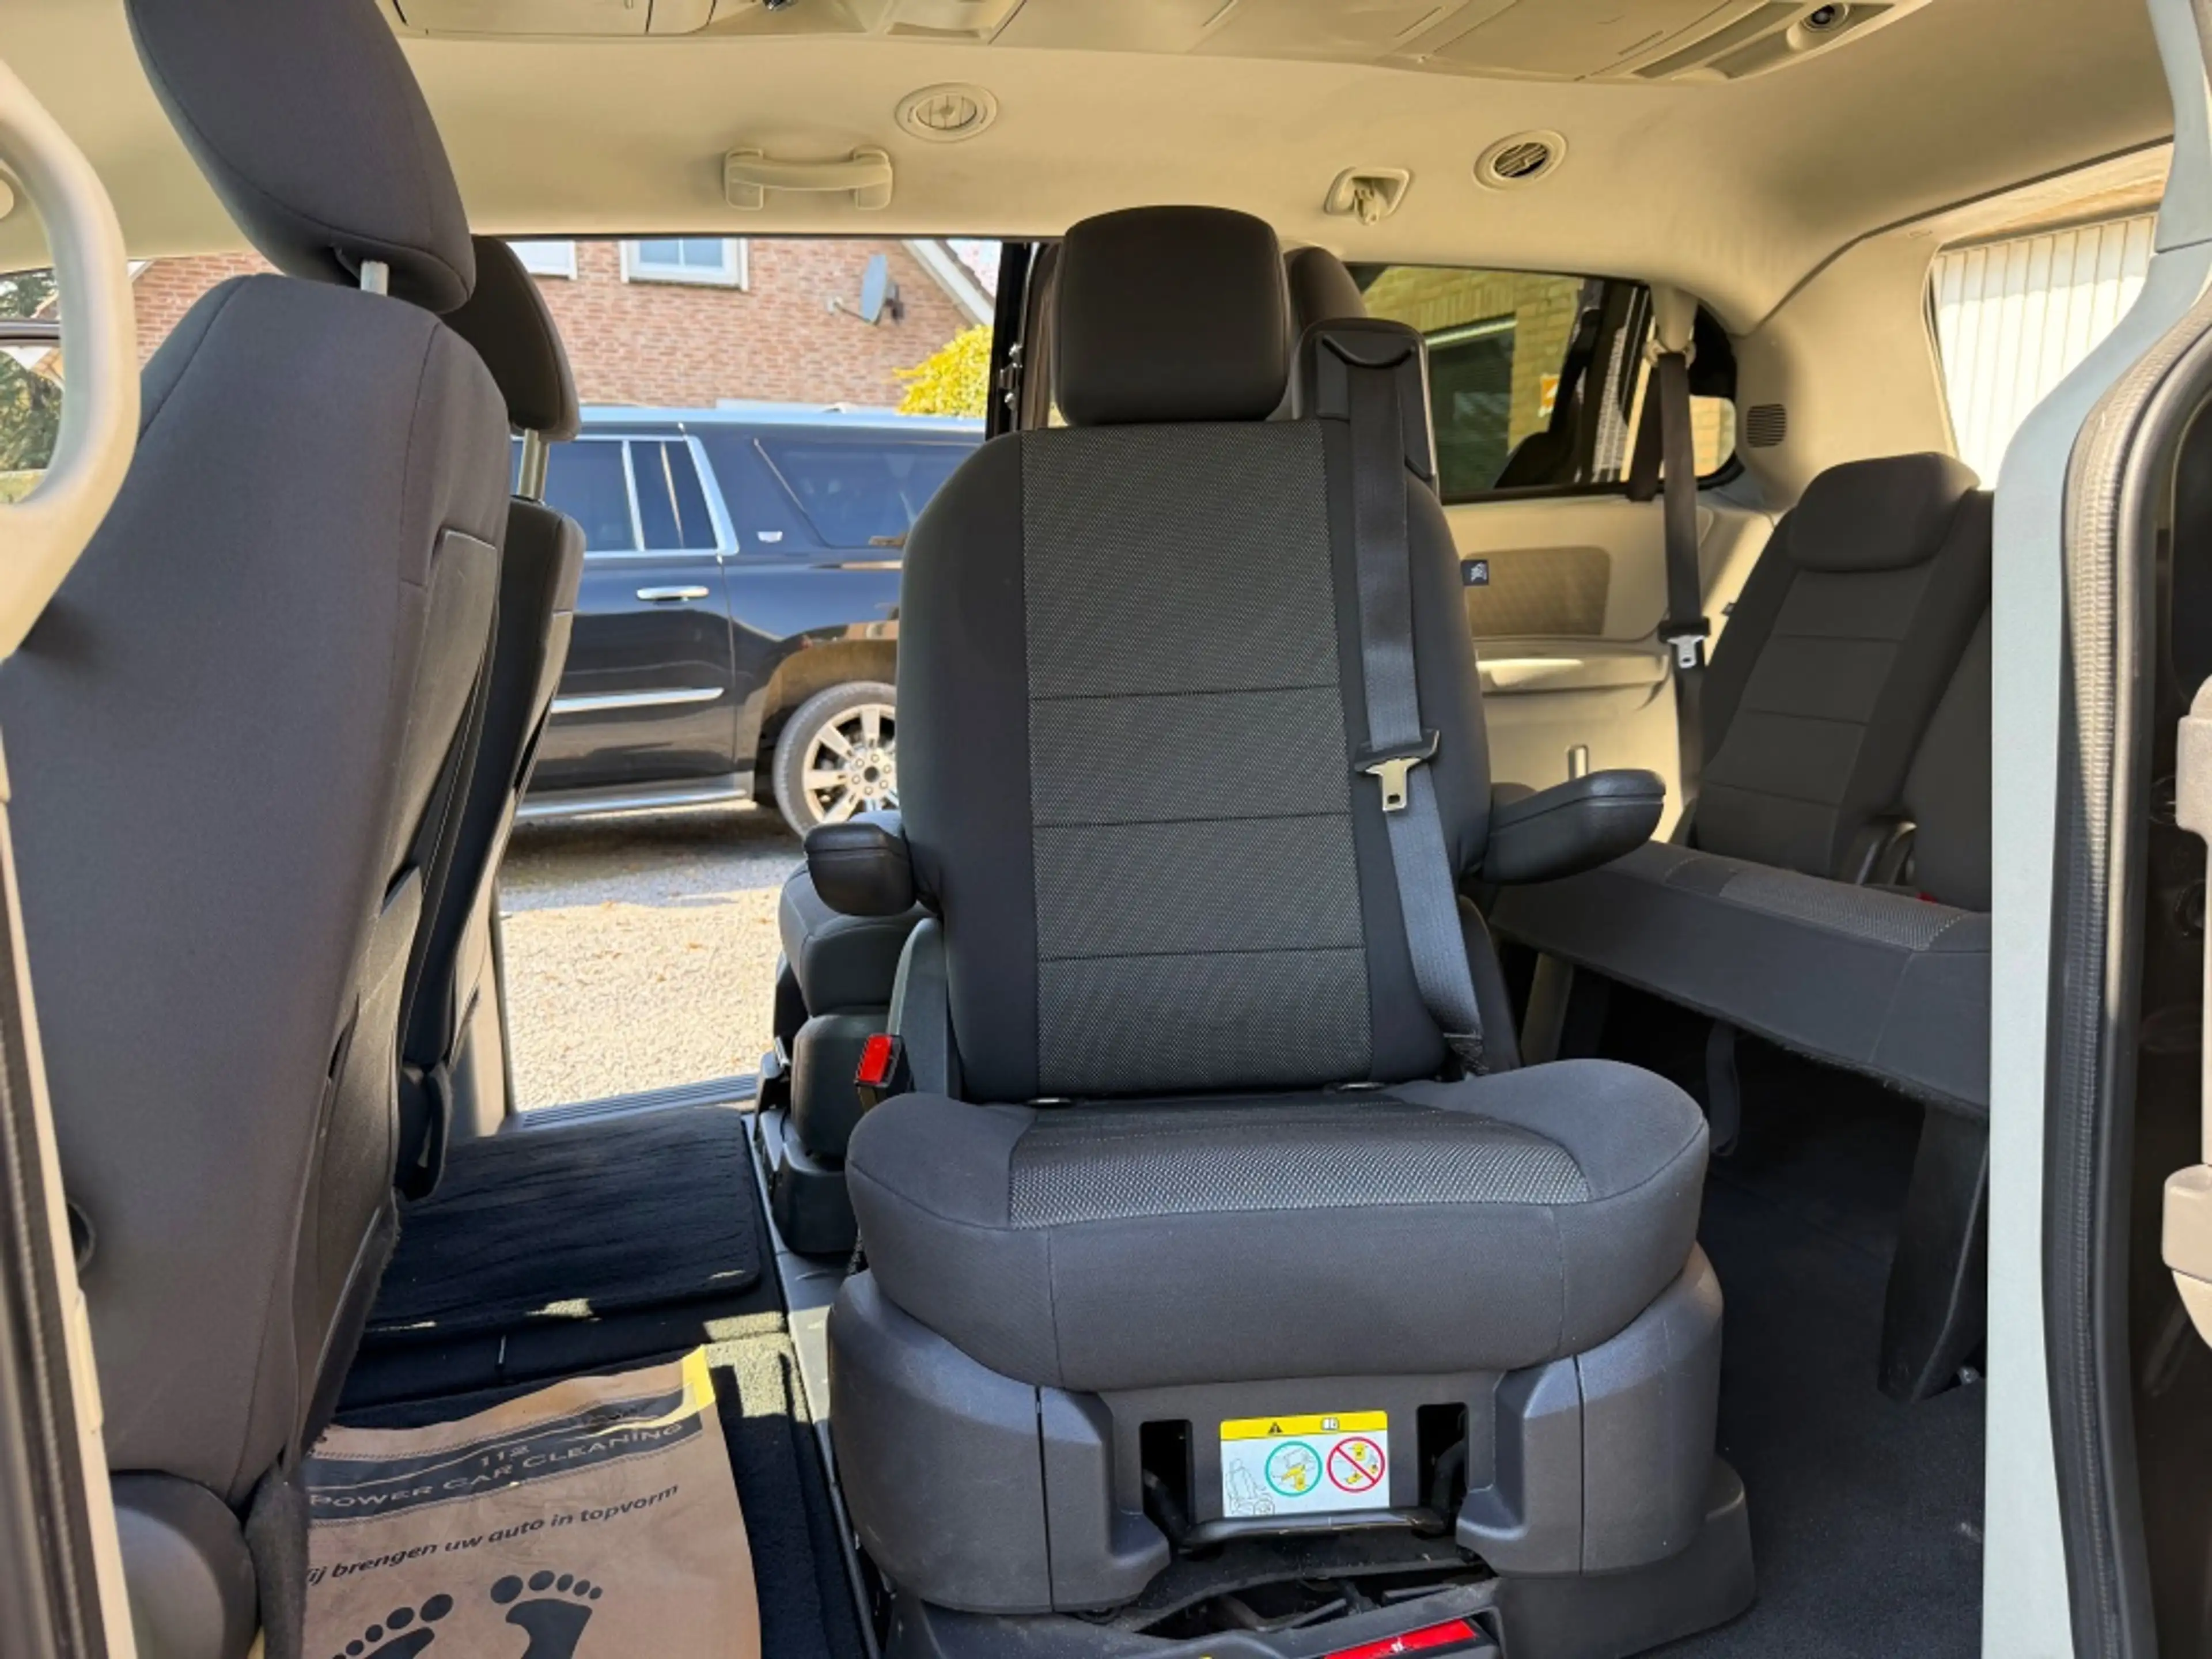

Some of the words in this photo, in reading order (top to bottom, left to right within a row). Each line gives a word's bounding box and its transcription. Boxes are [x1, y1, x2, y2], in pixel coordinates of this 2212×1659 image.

[310, 1486, 433, 1507] POWER
[443, 1463, 513, 1490] CAR
[522, 1423, 683, 1468] CLEANING
[331, 1544, 438, 1578] brengen
[444, 1535, 483, 1552] uw
[488, 1518, 545, 1543] auto
[551, 1513, 573, 1527] in
[580, 1484, 679, 1522] topvorm
